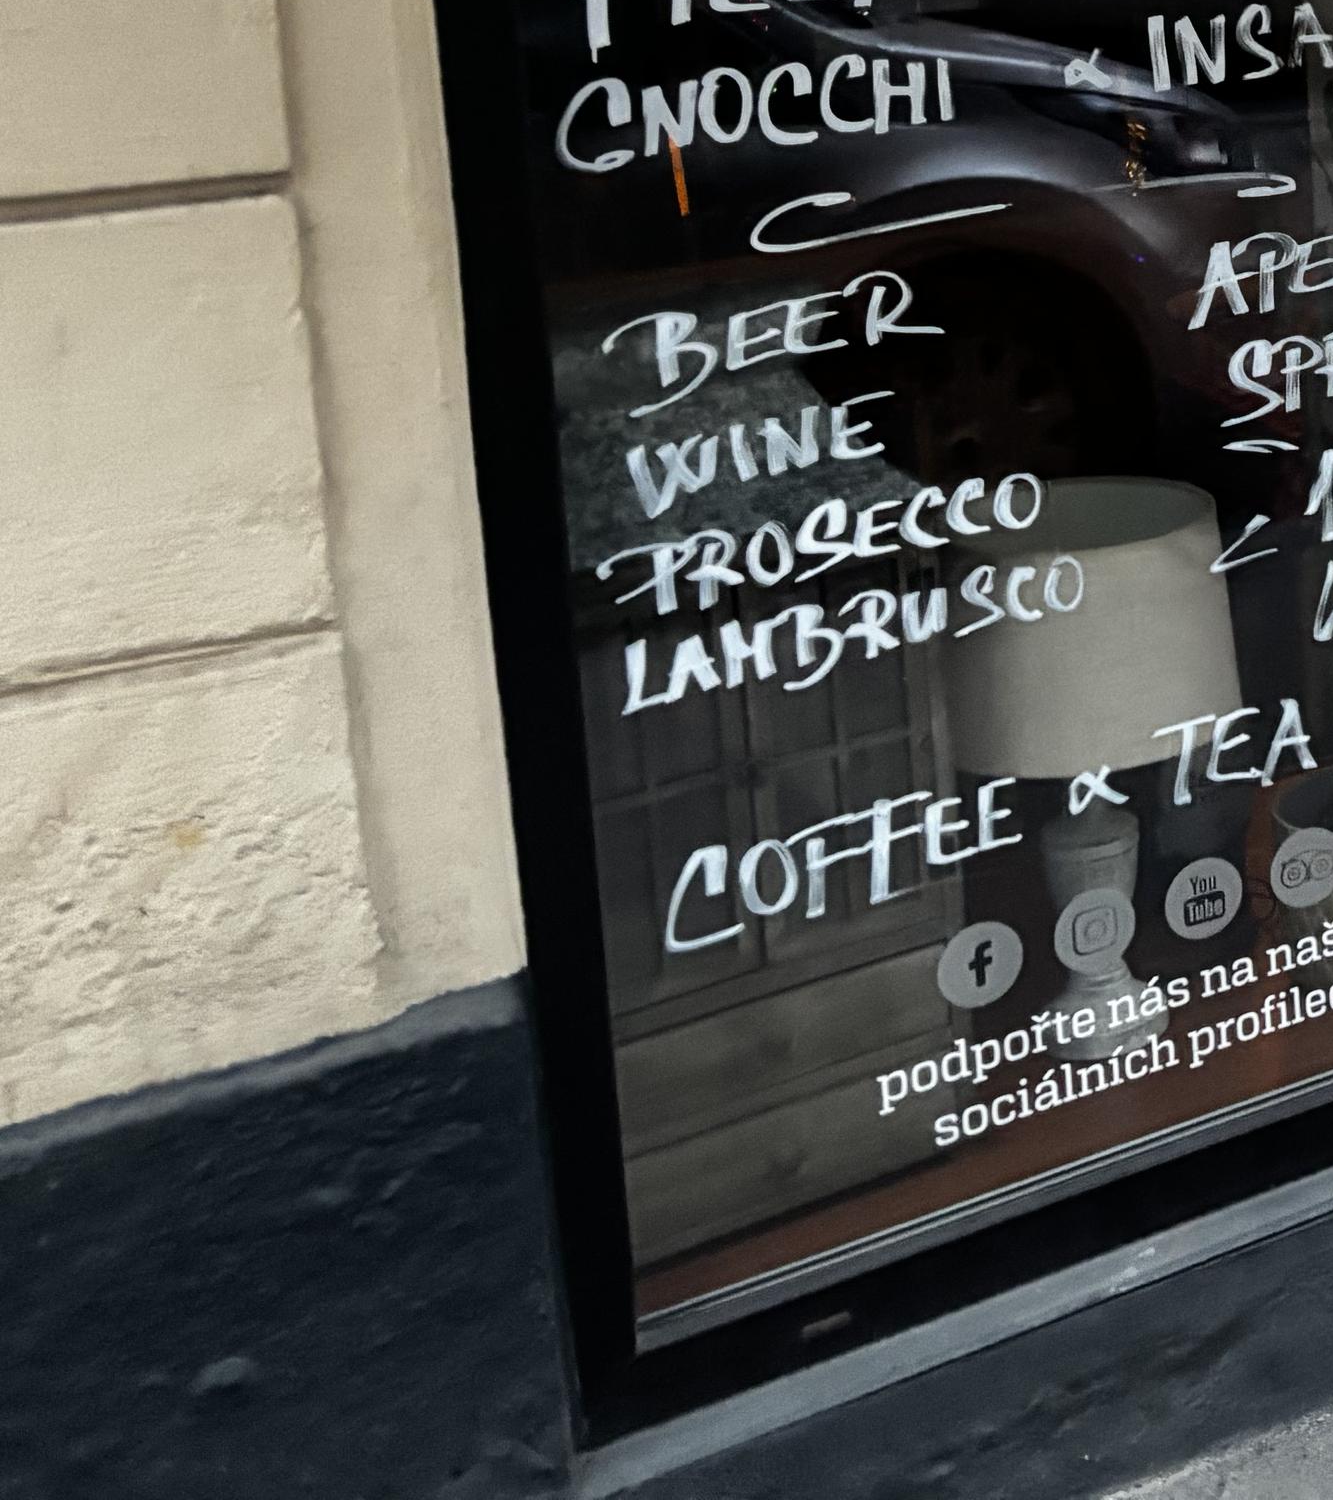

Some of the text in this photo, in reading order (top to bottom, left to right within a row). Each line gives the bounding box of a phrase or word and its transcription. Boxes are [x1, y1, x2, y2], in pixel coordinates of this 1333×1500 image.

[603, 271, 944, 416] BEER
[625, 391, 894, 519] WINE
[596, 474, 1042, 613] PROSECCO
[623, 555, 1084, 715] LAMBRUSCO
[665, 699, 1317, 953] COFFEE TEA
[877, 1006, 1097, 1116] podpořte
[1108, 969, 1190, 1031] nás
[1201, 950, 1257, 999] na
[934, 1036, 1180, 1147] sociálních
